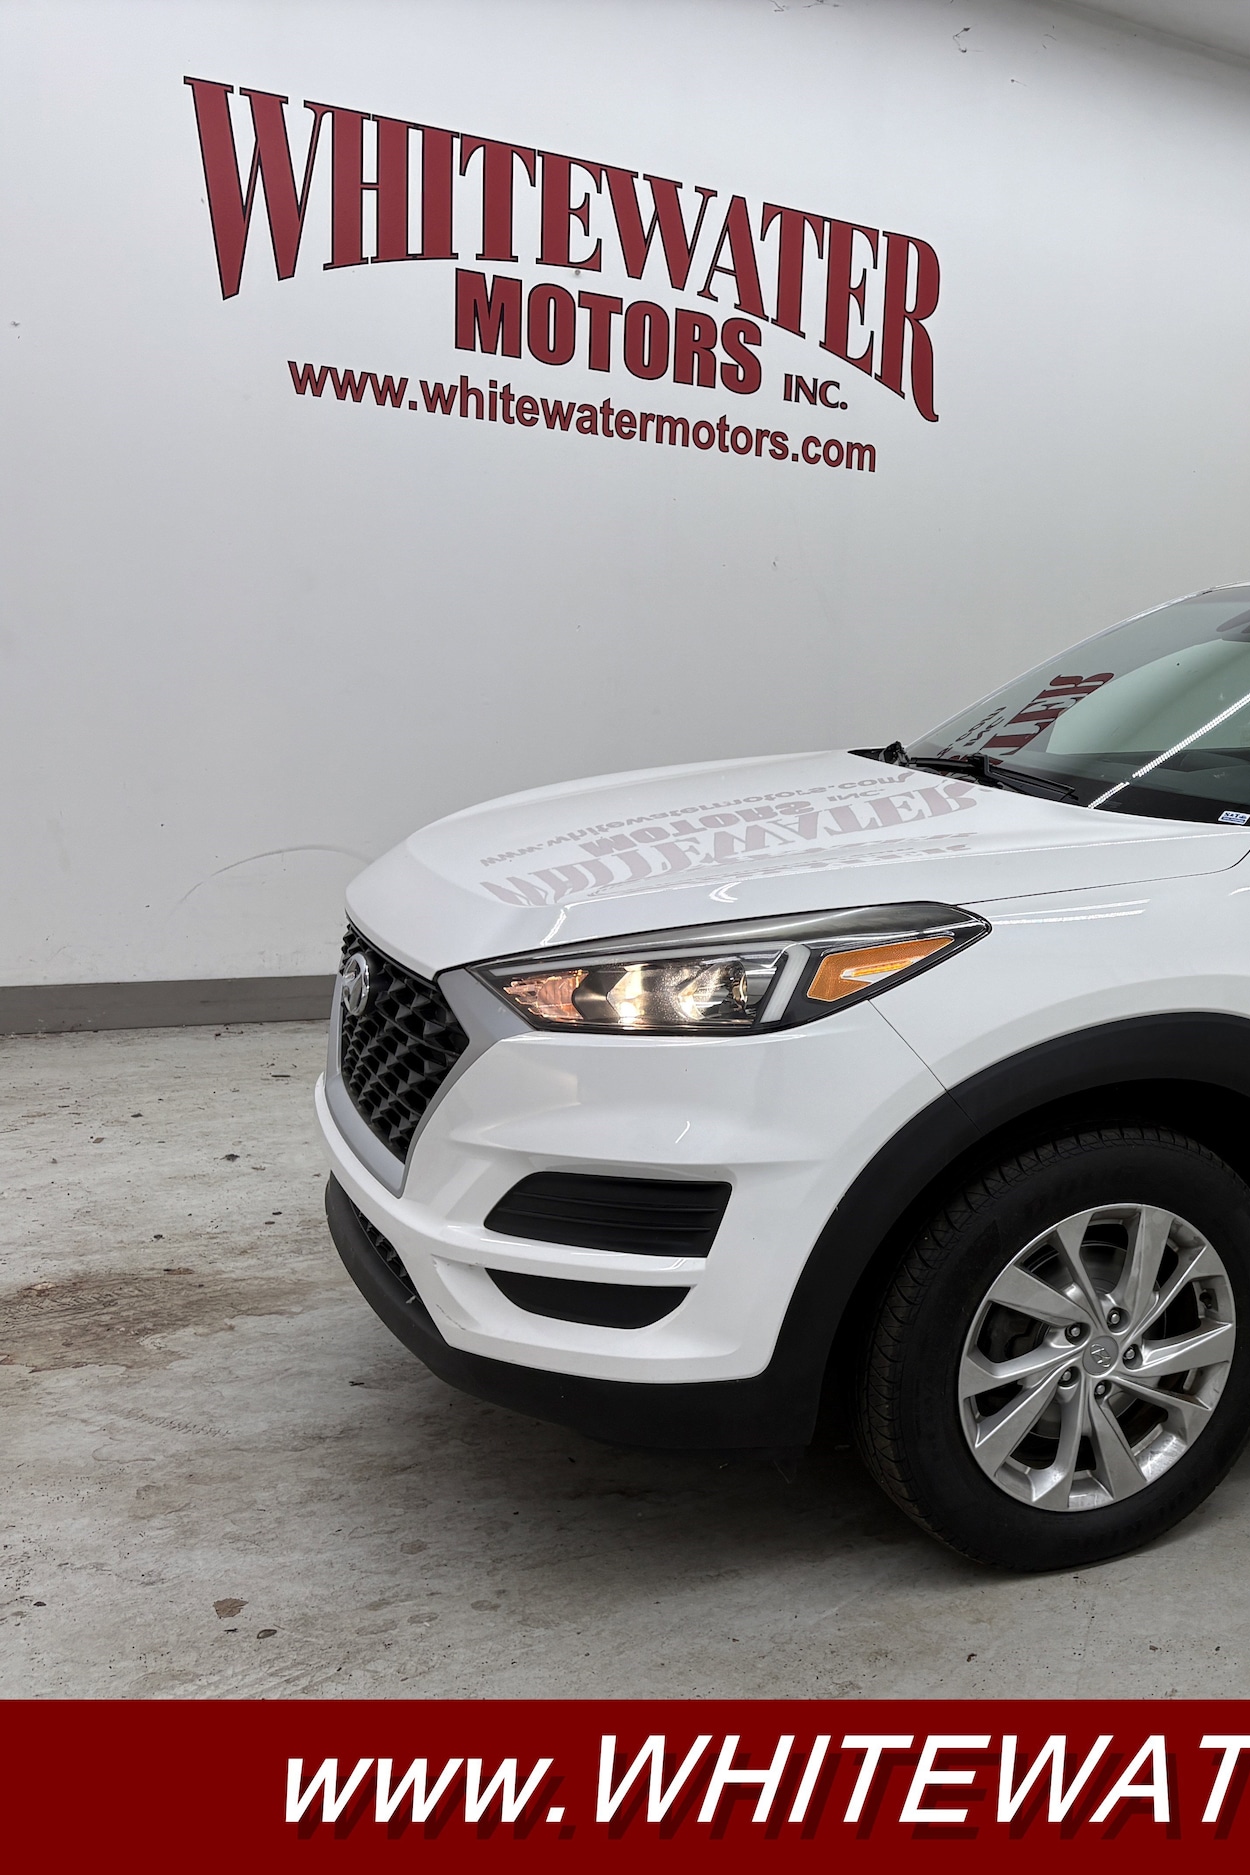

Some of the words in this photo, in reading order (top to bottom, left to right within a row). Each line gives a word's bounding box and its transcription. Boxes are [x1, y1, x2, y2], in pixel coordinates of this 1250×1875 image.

[184, 75, 941, 423] WHITEWATER
[455, 268, 762, 395] MOTORS
[783, 373, 848, 410] INC.
[288, 360, 876, 473] www.whitewatermotors.com
